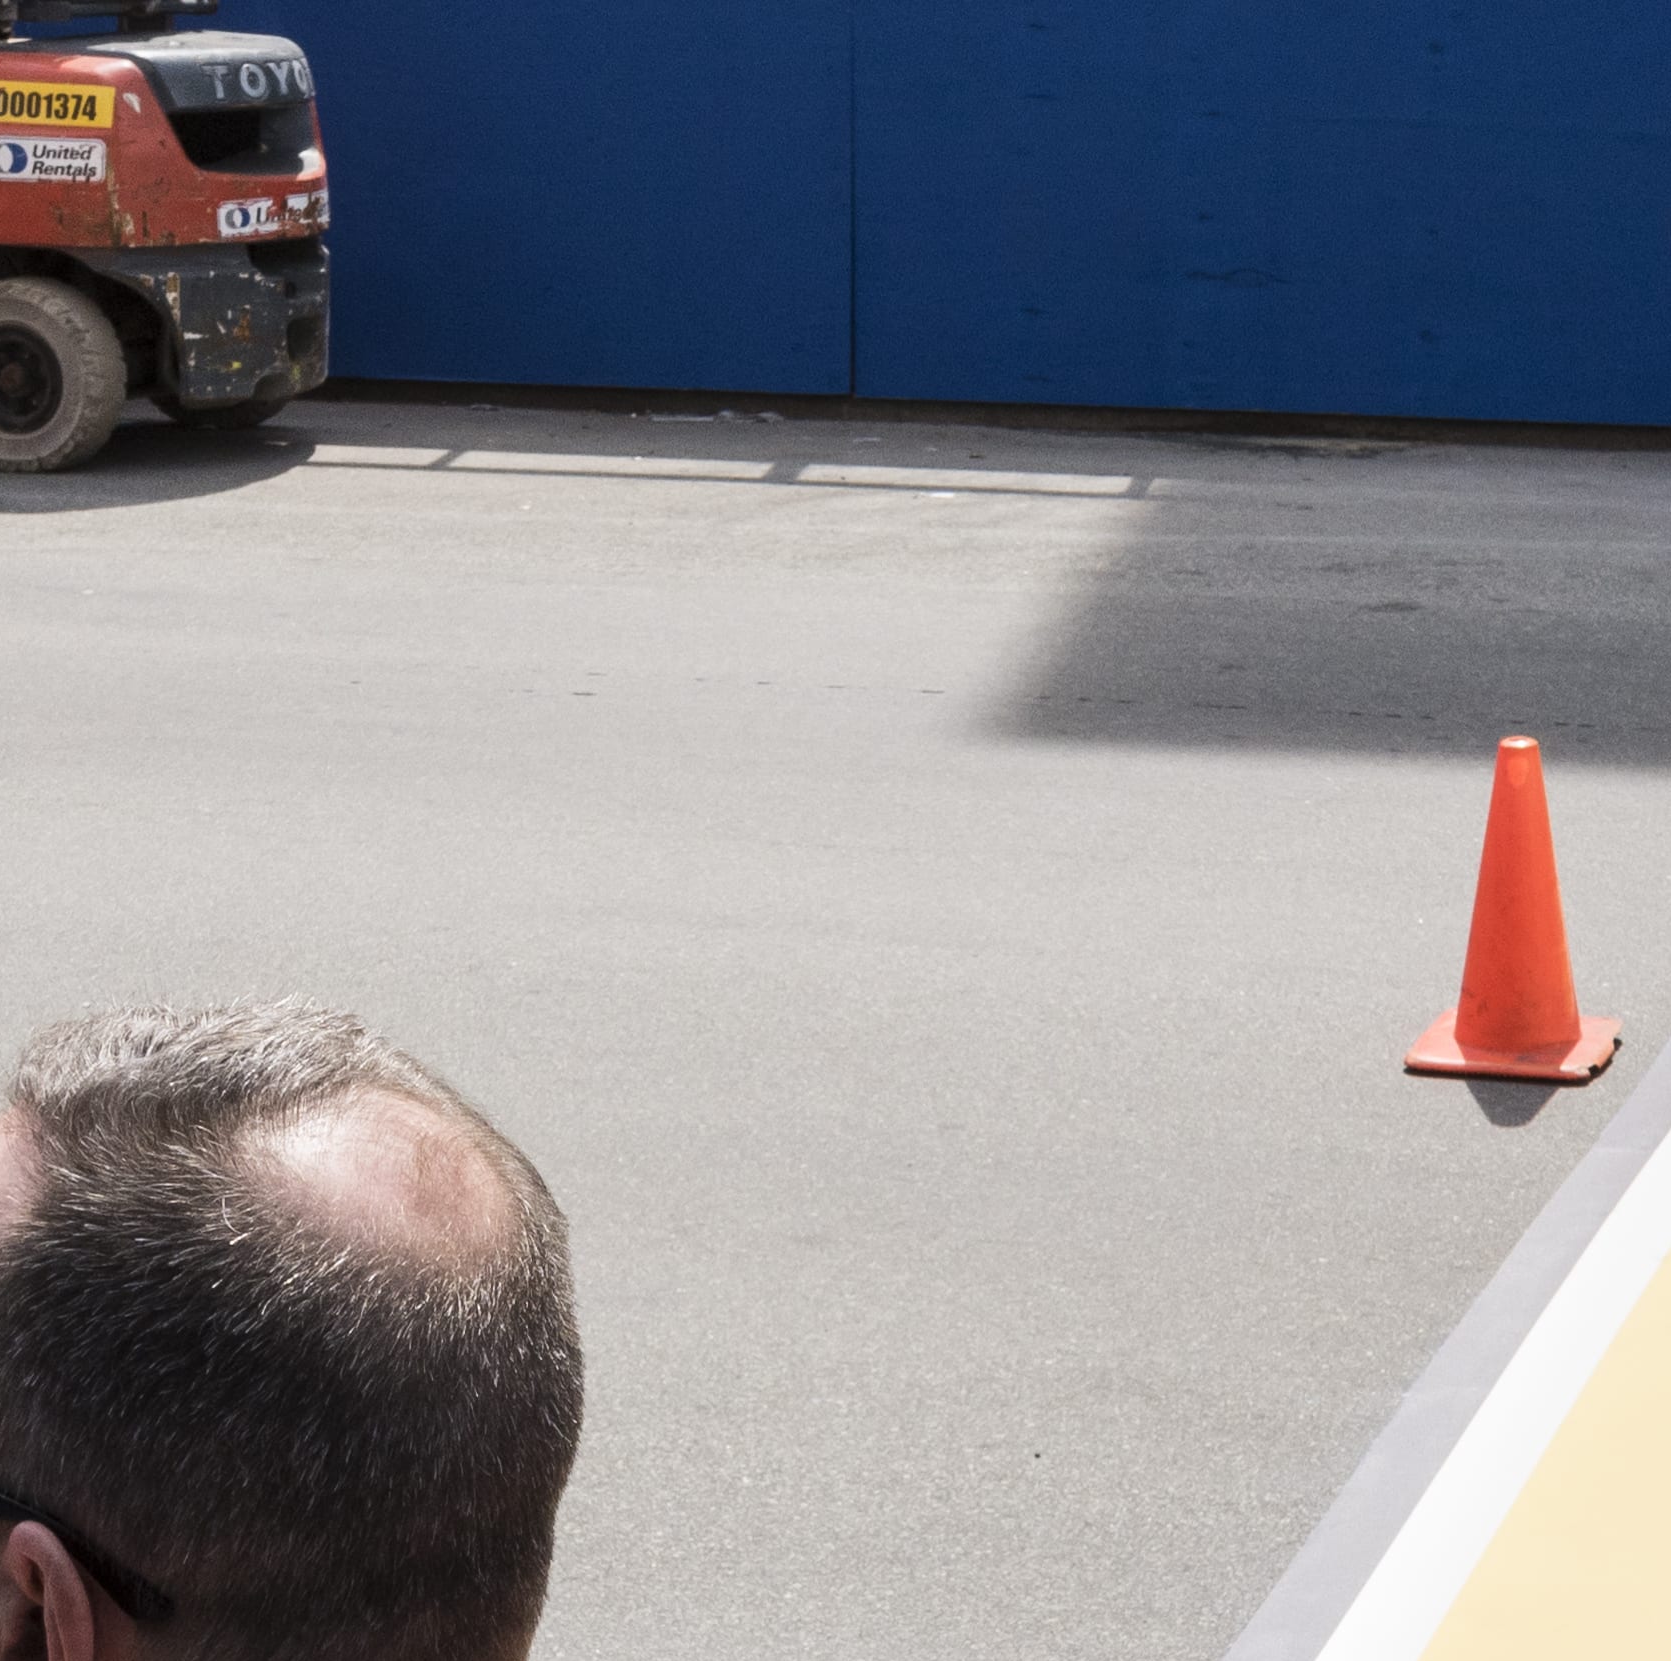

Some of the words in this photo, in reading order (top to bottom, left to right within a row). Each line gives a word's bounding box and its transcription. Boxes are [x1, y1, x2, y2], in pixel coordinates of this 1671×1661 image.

[200, 58, 316, 99] TOYO
[32, 143, 93, 160] United
[31, 160, 98, 177] Rentals
